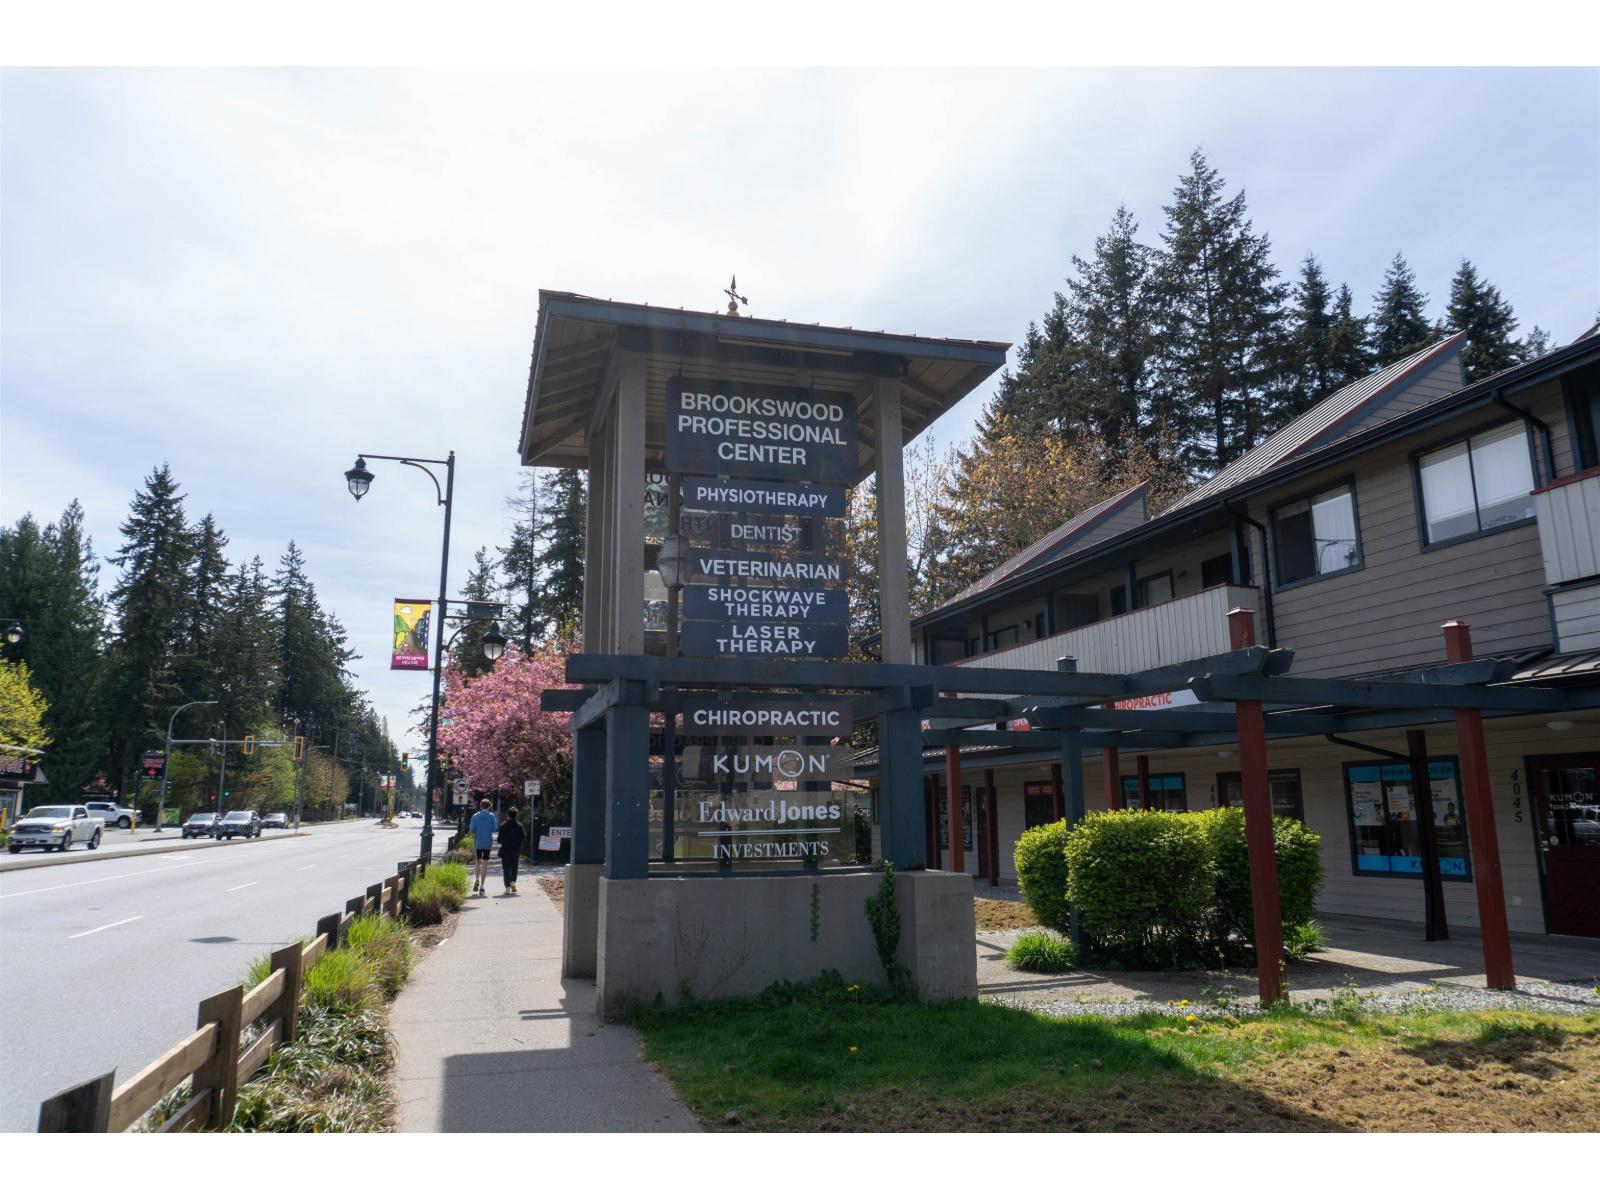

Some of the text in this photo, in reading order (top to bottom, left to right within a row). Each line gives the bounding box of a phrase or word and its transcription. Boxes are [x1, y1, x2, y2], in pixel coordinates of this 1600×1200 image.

[681, 392, 844, 422] BROOKSWOOD
[678, 415, 848, 445] PROFESSIONAL
[717, 442, 807, 465] CENTER
[697, 487, 828, 508] PHYSIOTHERAPY
[730, 524, 802, 542] DENTIST
[700, 558, 840, 580] VETERINARIAN
[707, 588, 826, 605] SHOCKWAVE
[725, 603, 811, 618] THERAPY
[732, 624, 801, 639] LASER
[716, 638, 817, 654] THERAPY
[1114, 692, 1172, 710] HIROPRACTIC
[693, 709, 840, 726] CHIROPRACTIC
[713, 750, 827, 777] KUMON
[1510, 768, 1522, 823] 4045
[1550, 791, 1593, 802] KUMON
[713, 841, 829, 859] INVESTMENTS
[1410, 858, 1463, 873] KON
